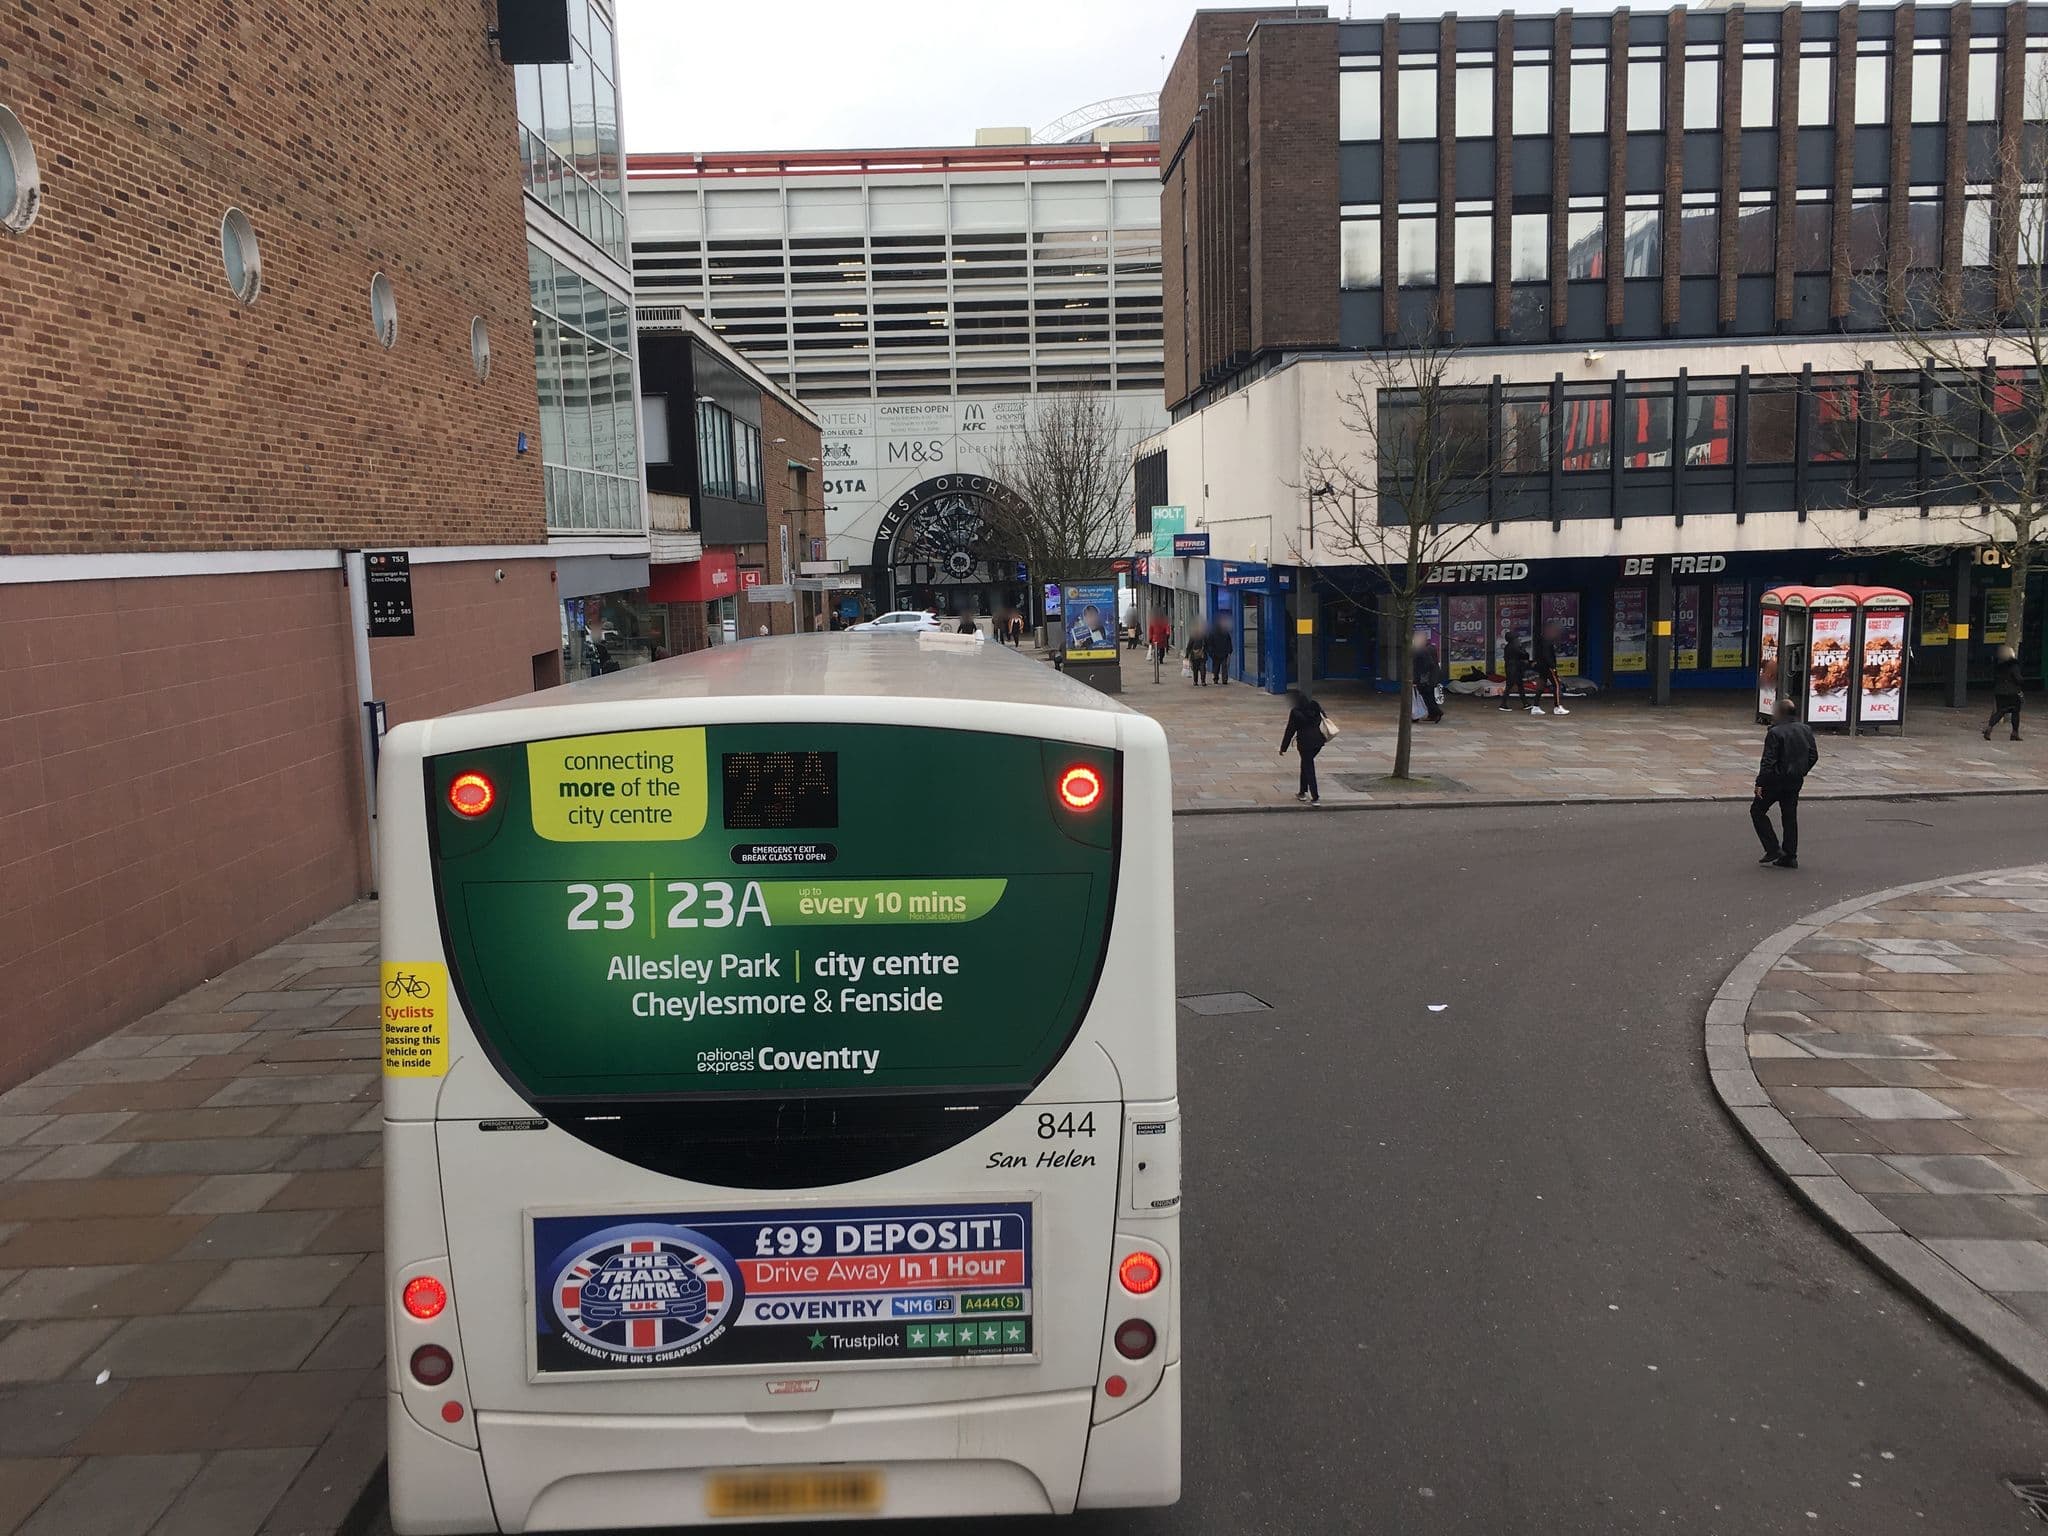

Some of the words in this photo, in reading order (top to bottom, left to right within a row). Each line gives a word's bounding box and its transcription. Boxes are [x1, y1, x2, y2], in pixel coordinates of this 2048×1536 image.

[880, 406, 922, 415] CANTEEN
[924, 405, 949, 414] OPEN
[817, 413, 866, 425] NTEEN
[962, 422, 986, 431] KFC
[888, 440, 943, 463] M&S
[823, 480, 866, 494] OSTA
[878, 489, 920, 541] WEST
[1427, 563, 1529, 583] BETFRED
[1624, 555, 1727, 576] BEFRED
[1229, 576, 1266, 585] BETFRED
[1454, 620, 1482, 631] £500
[1814, 655, 1847, 666] HOT
[1867, 654, 1899, 666] HOT
[1818, 705, 1837, 713] KFC
[564, 750, 674, 774] connecting
[559, 781, 615, 797] more
[621, 777, 641, 797] of
[646, 777, 680, 796] the
[728, 751, 829, 826] 23A
[568, 805, 604, 828] city
[610, 806, 672, 824] centre
[742, 854, 767, 862] BREAK
[794, 853, 804, 861] TO
[805, 853, 826, 861] OPEN
[752, 846, 797, 854] EMERGENCY
[799, 845, 816, 853] EXIT
[798, 887, 811, 897] up
[812, 887, 822, 896] to
[567, 883, 635, 930] 23
[667, 881, 771, 928] 23A
[799, 896, 868, 919] every
[874, 892, 902, 913] 10
[909, 891, 966, 913] mins
[606, 954, 713, 984] Allesley
[720, 953, 780, 978] Park
[815, 951, 865, 982] city
[872, 951, 959, 976] centre
[632, 991, 806, 1021] Cheylesmore
[813, 988, 833, 1013] &
[840, 986, 943, 1012] Fenside
[385, 1006, 434, 1020] Cyclists
[385, 1024, 420, 1033] Beware
[422, 1024, 432, 1033] of
[385, 1036, 420, 1046] passing
[422, 1035, 440, 1044] this
[386, 1047, 417, 1056] vehicle
[420, 1048, 432, 1056] on
[697, 1047, 754, 1062] national
[386, 1058, 399, 1067] the
[402, 1058, 431, 1067] inside
[697, 1061, 755, 1075] express
[758, 1046, 880, 1075] Coventry
[1037, 1111, 1096, 1139] 844
[985, 1152, 1027, 1169] San
[1036, 1149, 1096, 1168] Helen
[755, 1226, 823, 1256] £99
[836, 1220, 1002, 1254] DEPOSIT!
[618, 1255, 669, 1268] THE
[756, 1262, 819, 1284] Drive
[827, 1261, 891, 1284] Away
[899, 1258, 921, 1279] In
[928, 1257, 938, 1277] 1
[947, 1255, 1006, 1277] Hour
[600, 1268, 688, 1284] TRADE
[607, 1282, 681, 1300] CENTRE
[629, 1302, 659, 1310] UK
[754, 1298, 884, 1321] COVENTRY
[909, 1296, 933, 1312] M6
[936, 1298, 950, 1310] J3
[966, 1296, 1020, 1310] A444(S)
[562, 1331, 608, 1359] PROBABLY
[610, 1353, 628, 1363] THE
[630, 1354, 653, 1363] UK'S
[655, 1342, 703, 1362] CHEAPEST
[703, 1324, 727, 1345] CARS
[830, 1333, 900, 1350] Trustpilot
